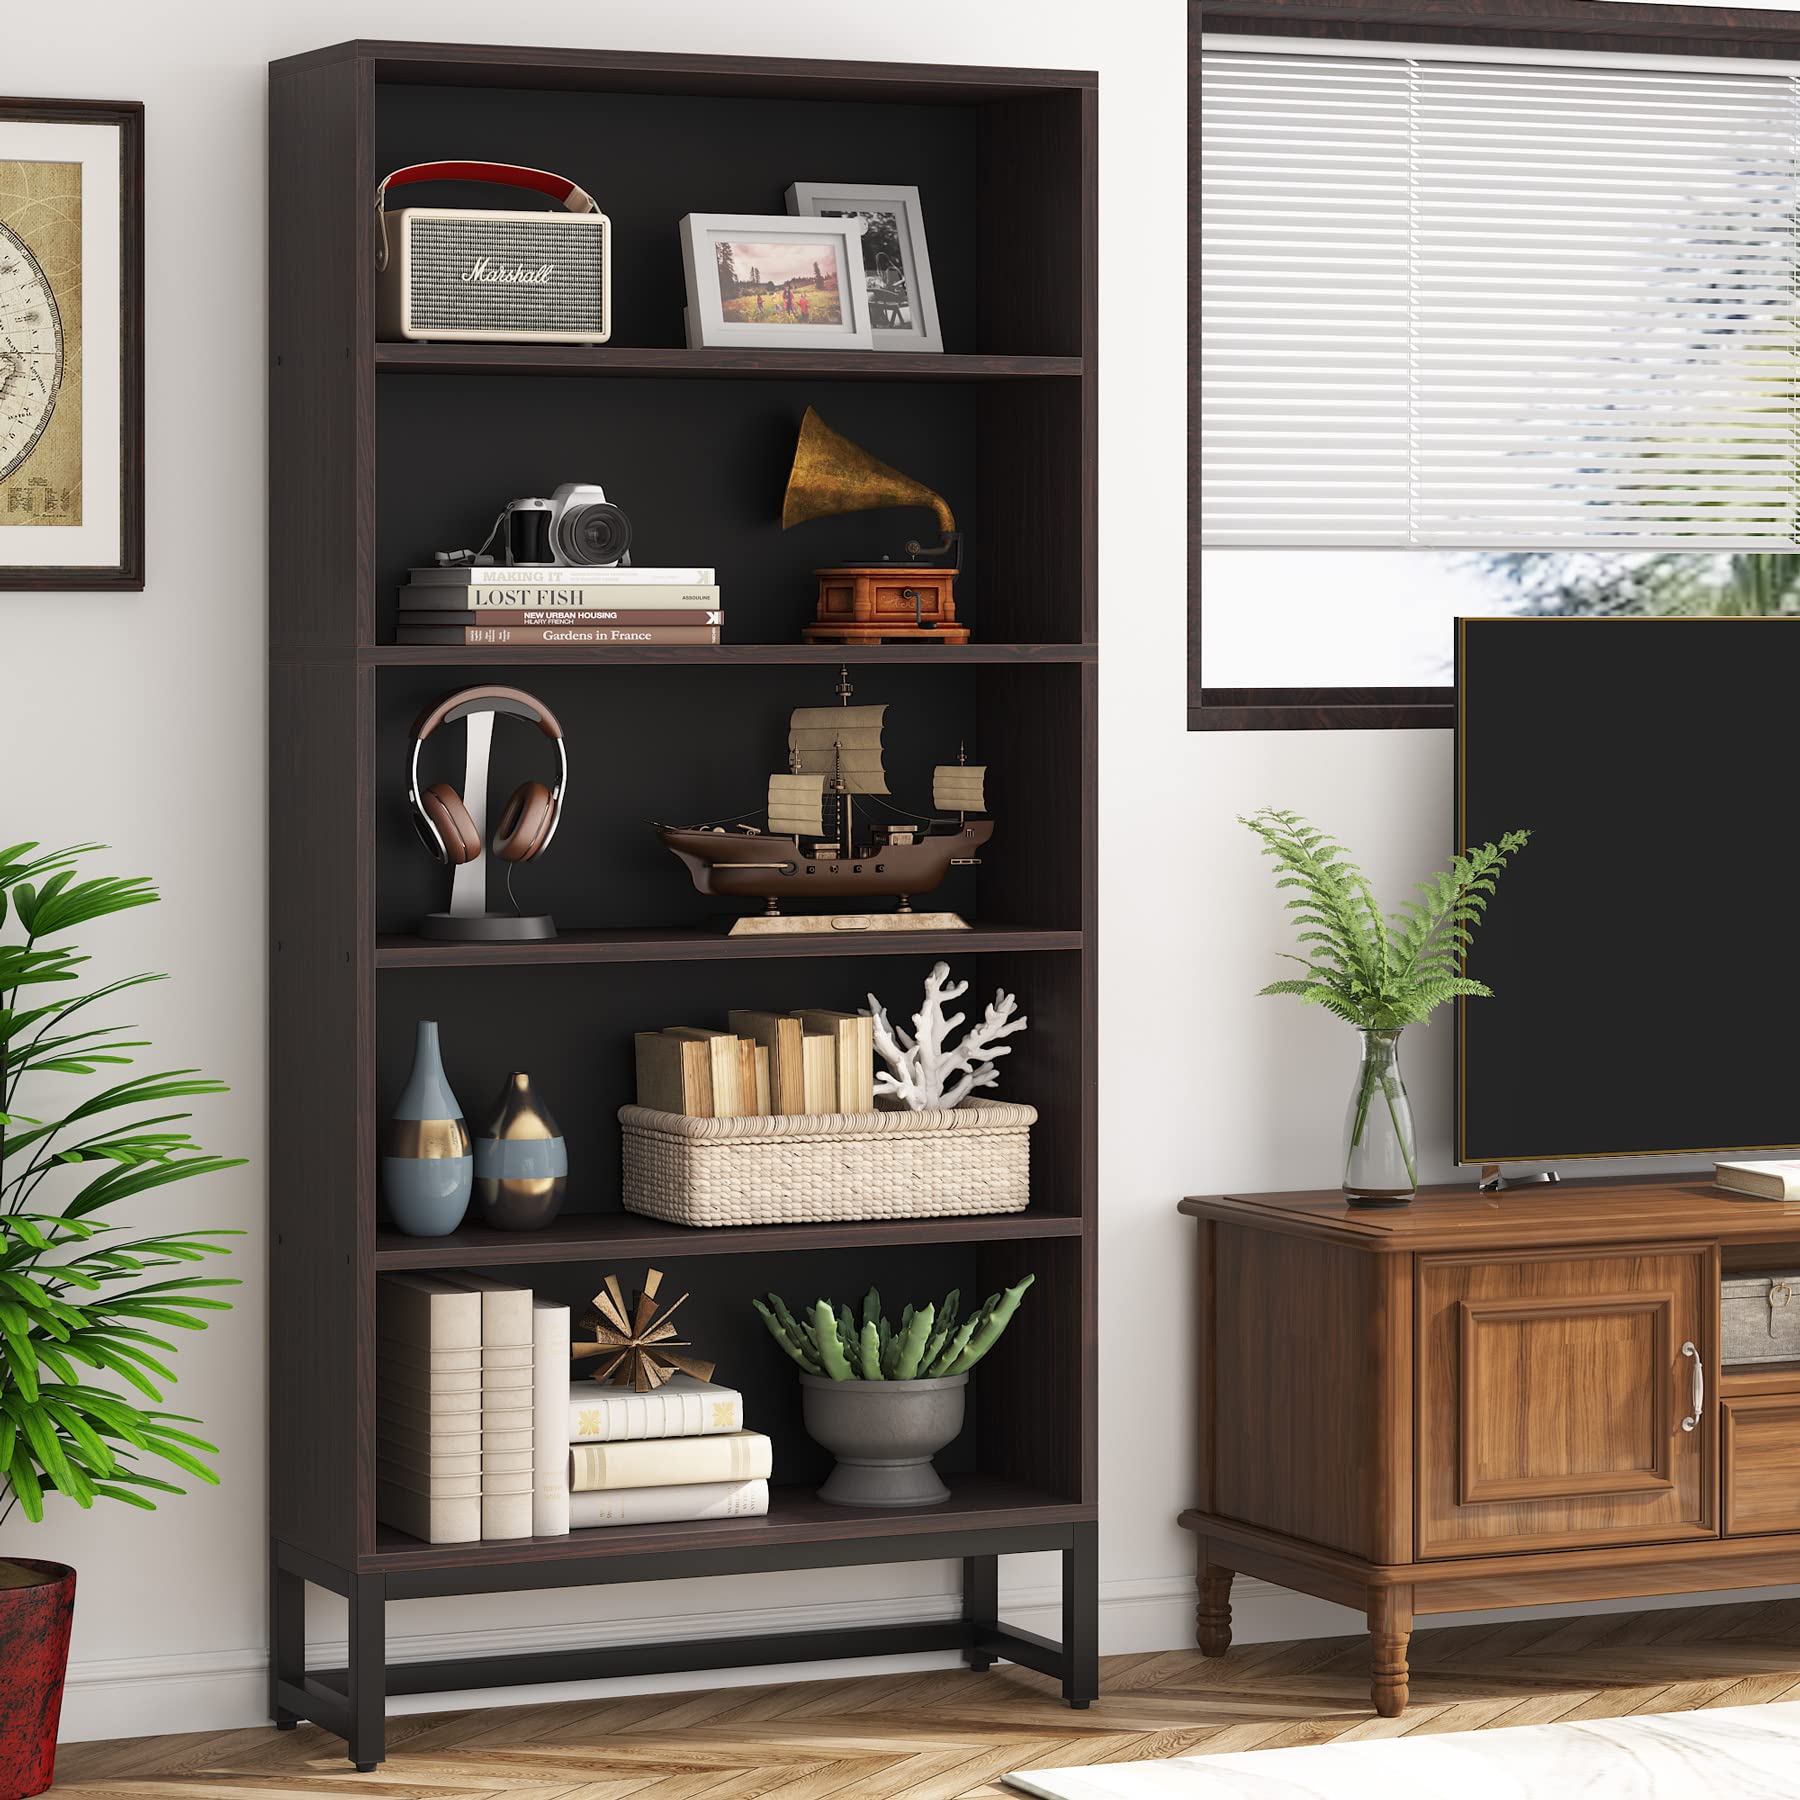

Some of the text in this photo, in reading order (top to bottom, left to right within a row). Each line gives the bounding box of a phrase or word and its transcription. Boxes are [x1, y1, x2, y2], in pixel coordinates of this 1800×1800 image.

[461, 256, 555, 284] Marshall
[483, 571, 545, 582] MAKING
[548, 571, 564, 582] IT
[475, 589, 584, 606] LOST FISH
[543, 630, 652, 641] Gardens in France
